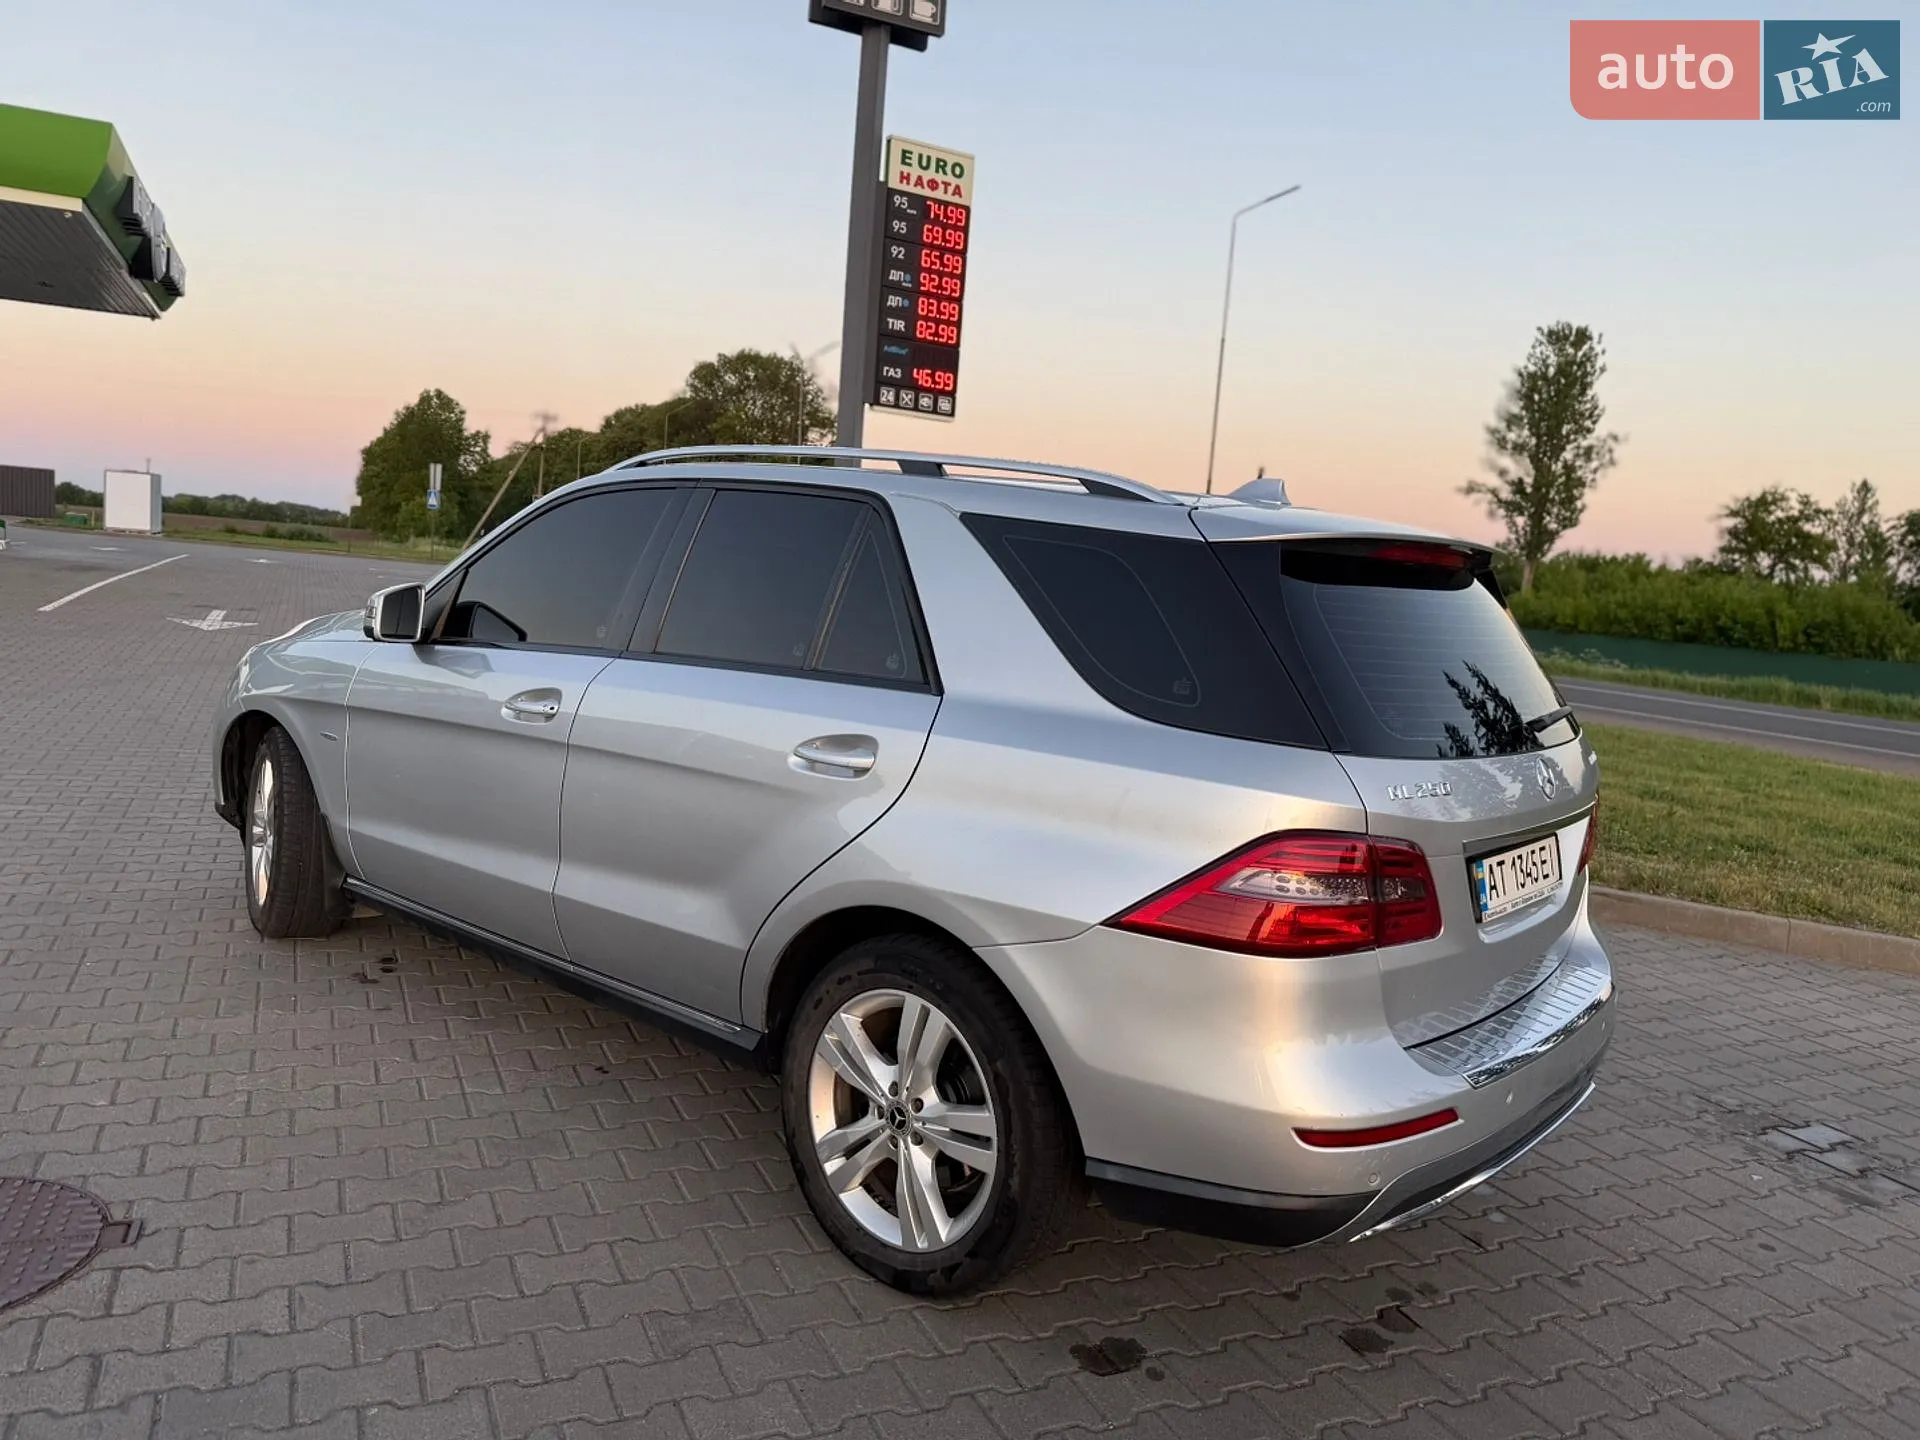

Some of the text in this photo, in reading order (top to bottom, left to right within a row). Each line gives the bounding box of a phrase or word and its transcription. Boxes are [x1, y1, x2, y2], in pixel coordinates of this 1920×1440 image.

[900, 148, 965, 179] EURO
[899, 170, 963, 198] НАФТА
[893, 195, 966, 227] 95 74.99
[892, 220, 965, 250] 95 69.99
[890, 245, 963, 275] 92 65.99
[919, 272, 961, 298] 92.99
[918, 296, 959, 322] 83.99
[886, 317, 957, 344] TIR 82.99
[882, 366, 954, 391] ГАЗ 46.99
